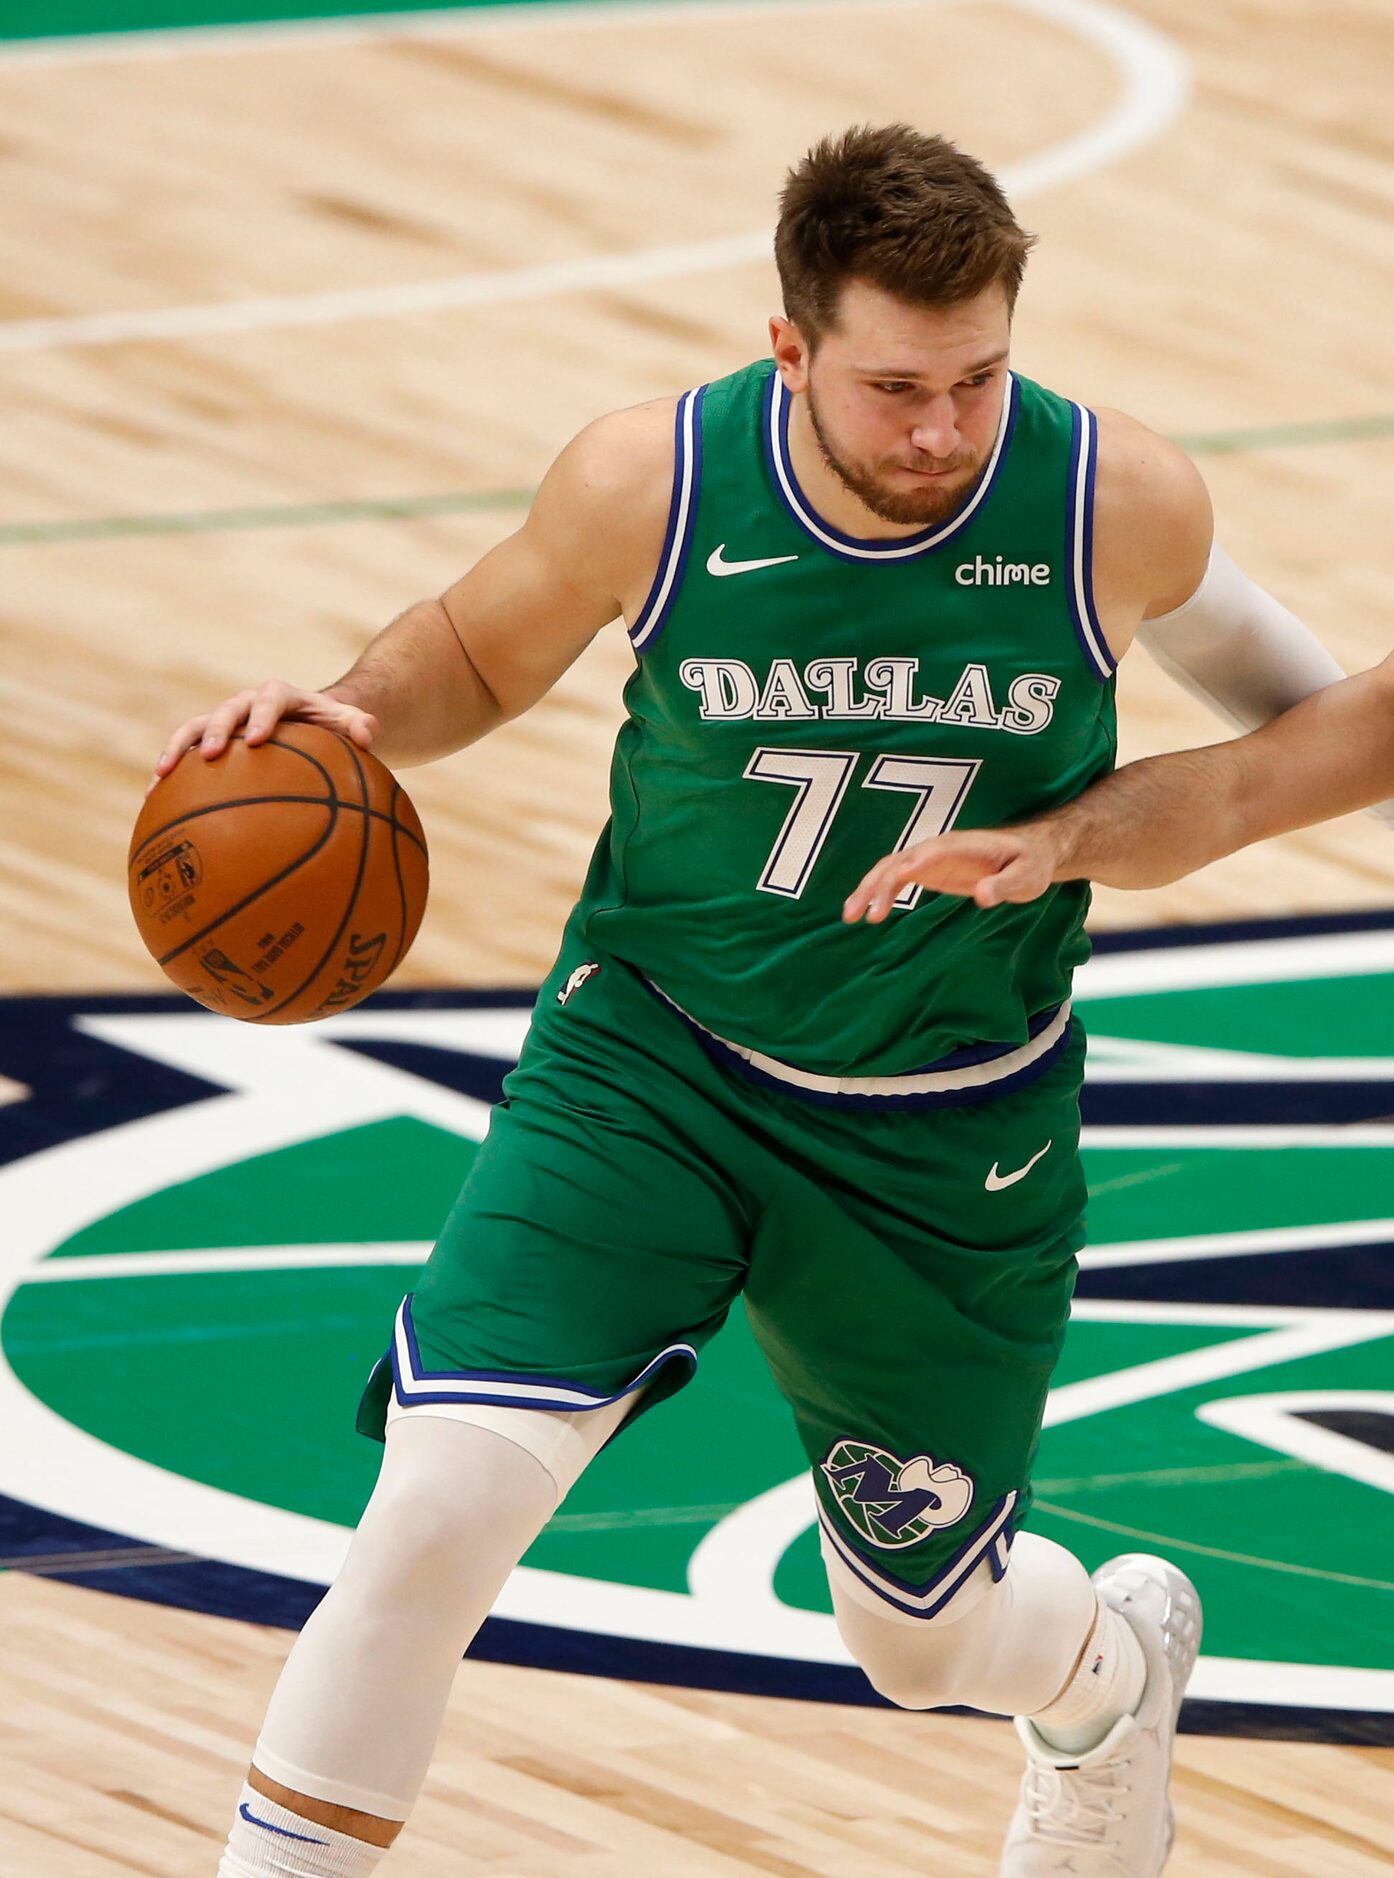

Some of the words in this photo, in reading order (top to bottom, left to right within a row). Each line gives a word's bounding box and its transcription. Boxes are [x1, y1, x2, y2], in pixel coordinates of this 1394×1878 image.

[955, 554, 1050, 585] chime
[679, 657, 1062, 735] DALLAS
[742, 747, 984, 910] 77
[317, 932, 387, 1010] SPAL
